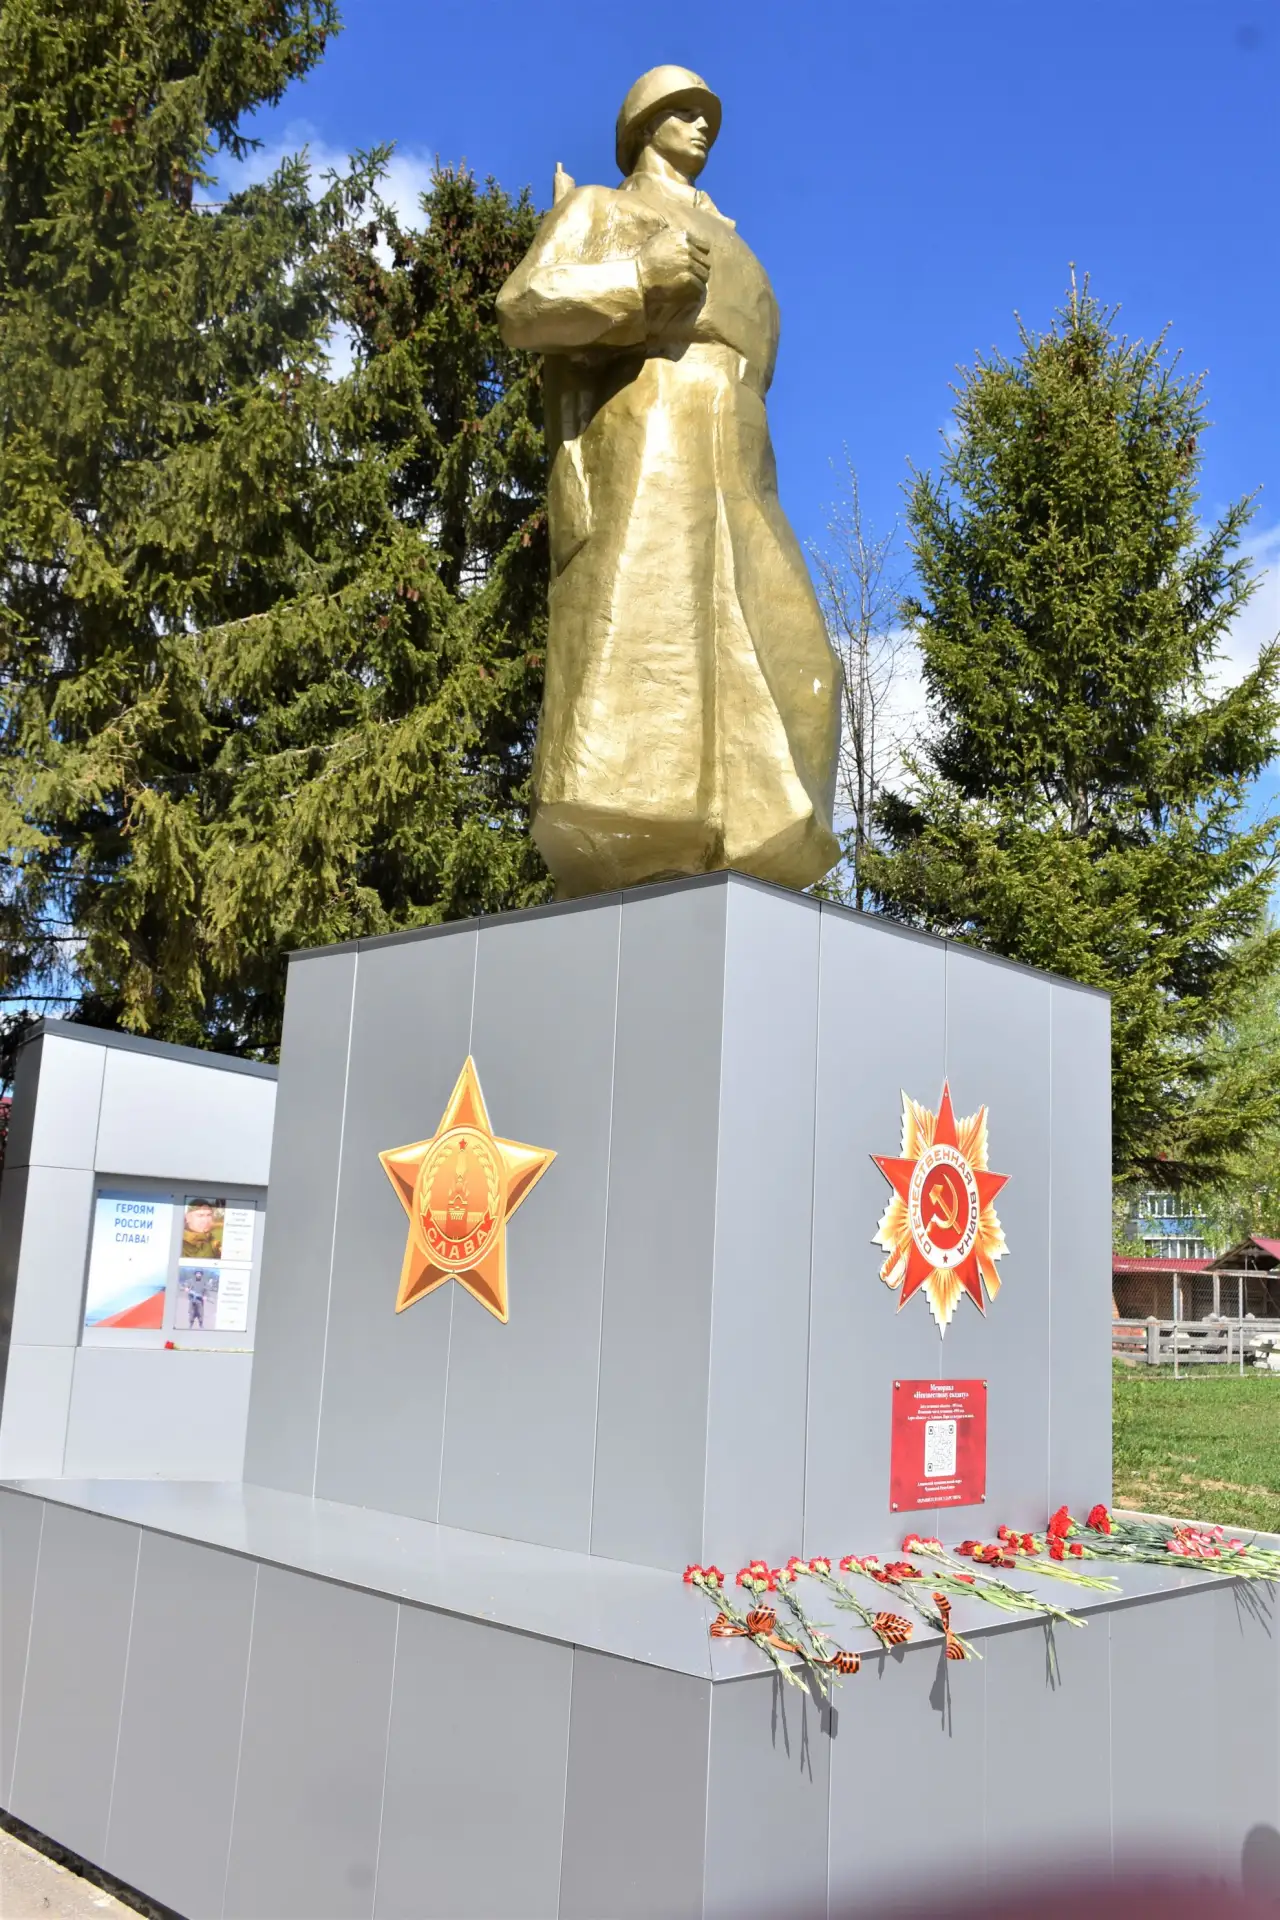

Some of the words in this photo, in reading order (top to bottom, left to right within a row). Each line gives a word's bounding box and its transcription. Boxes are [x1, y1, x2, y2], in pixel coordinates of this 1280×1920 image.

[912, 1149, 973, 1255] ОТЕЧЕСТВЕННАЯ
[116, 1203, 154, 1215] ГЕРОЯМ
[114, 1218, 153, 1230] РОССИИ
[115, 1232, 150, 1244] СЛАВА!
[427, 1227, 488, 1259] СЛАВА
